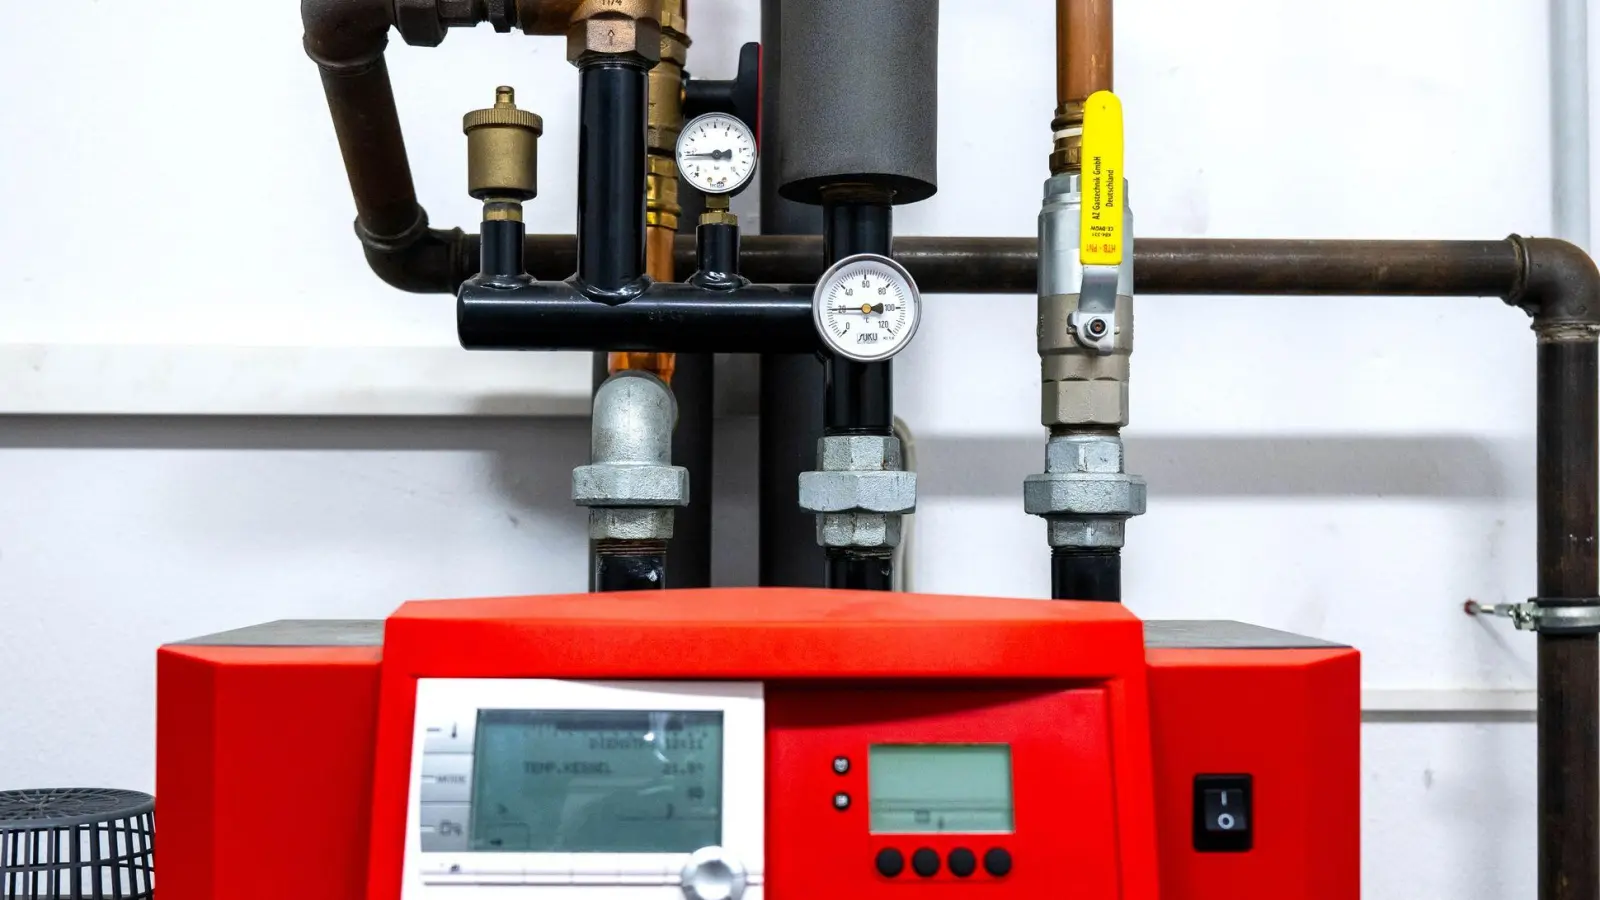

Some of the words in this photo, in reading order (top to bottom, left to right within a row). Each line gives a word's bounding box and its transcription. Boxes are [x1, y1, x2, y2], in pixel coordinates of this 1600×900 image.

[1093, 156, 1101, 175] GmbH
[1092, 176, 1101, 210] Gastechnik
[1105, 169, 1114, 208] Deutschland
[1092, 212, 1100, 220] AZ
[861, 280, 870, 288] 60
[845, 288, 853, 296] 40
[878, 287, 886, 295] 80
[884, 303, 895, 312] 100
[845, 321, 850, 330] 0
[878, 320, 889, 329] 120
